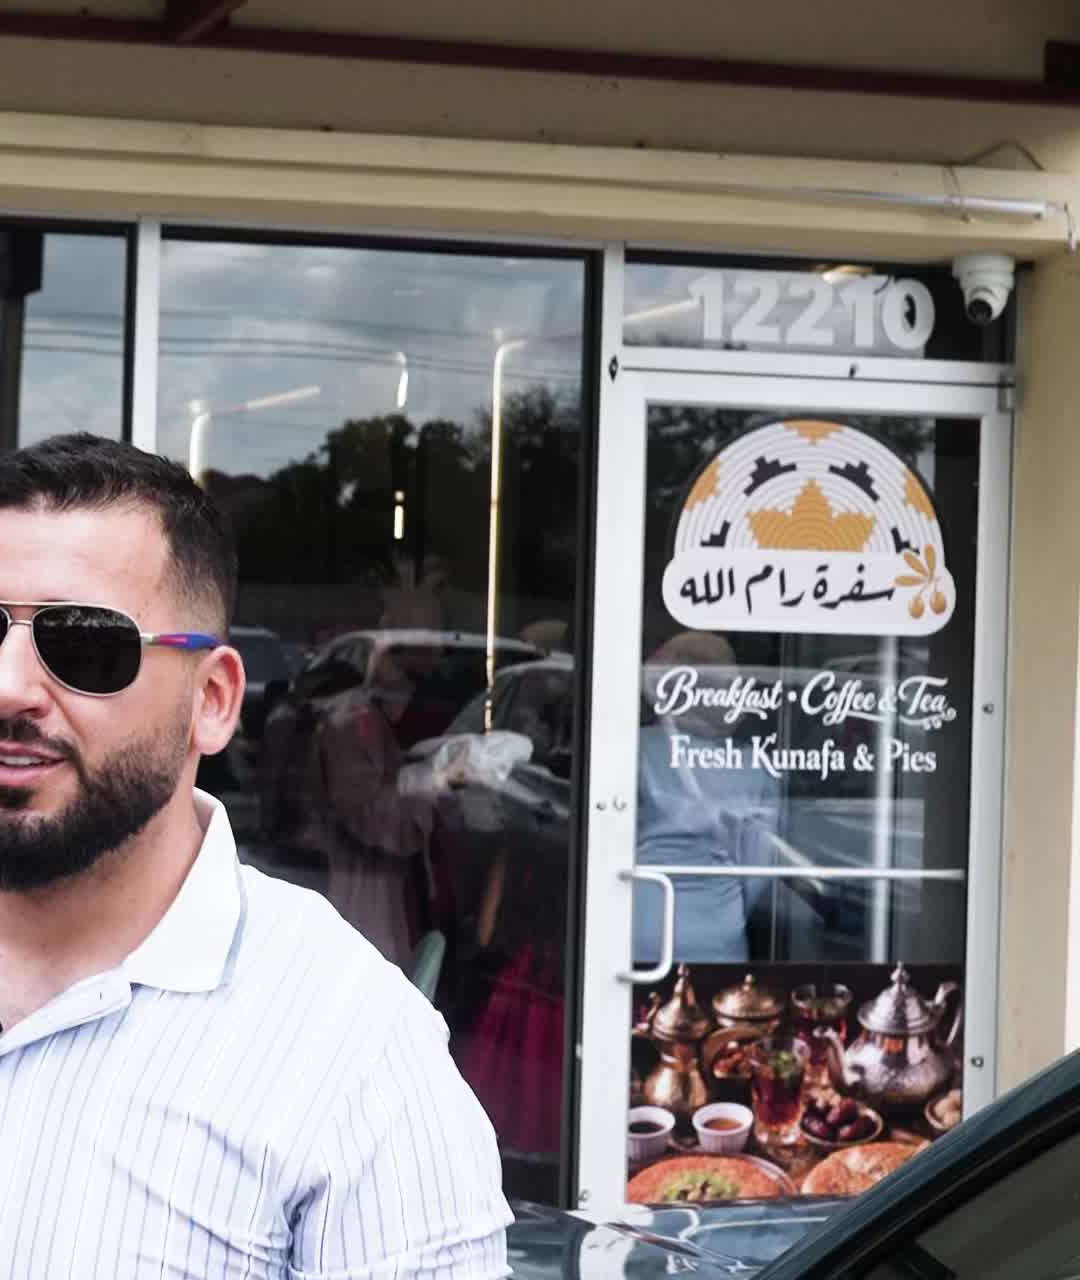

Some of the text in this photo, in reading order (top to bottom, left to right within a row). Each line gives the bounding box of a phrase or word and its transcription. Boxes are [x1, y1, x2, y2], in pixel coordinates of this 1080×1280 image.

[689, 276, 936, 352] 12210
[680, 563, 896, 615] سفرة رام الله
[654, 665, 950, 726] Breakfast Coffee & Tea
[669, 732, 937, 780] Fresh Kunafa & Pies
